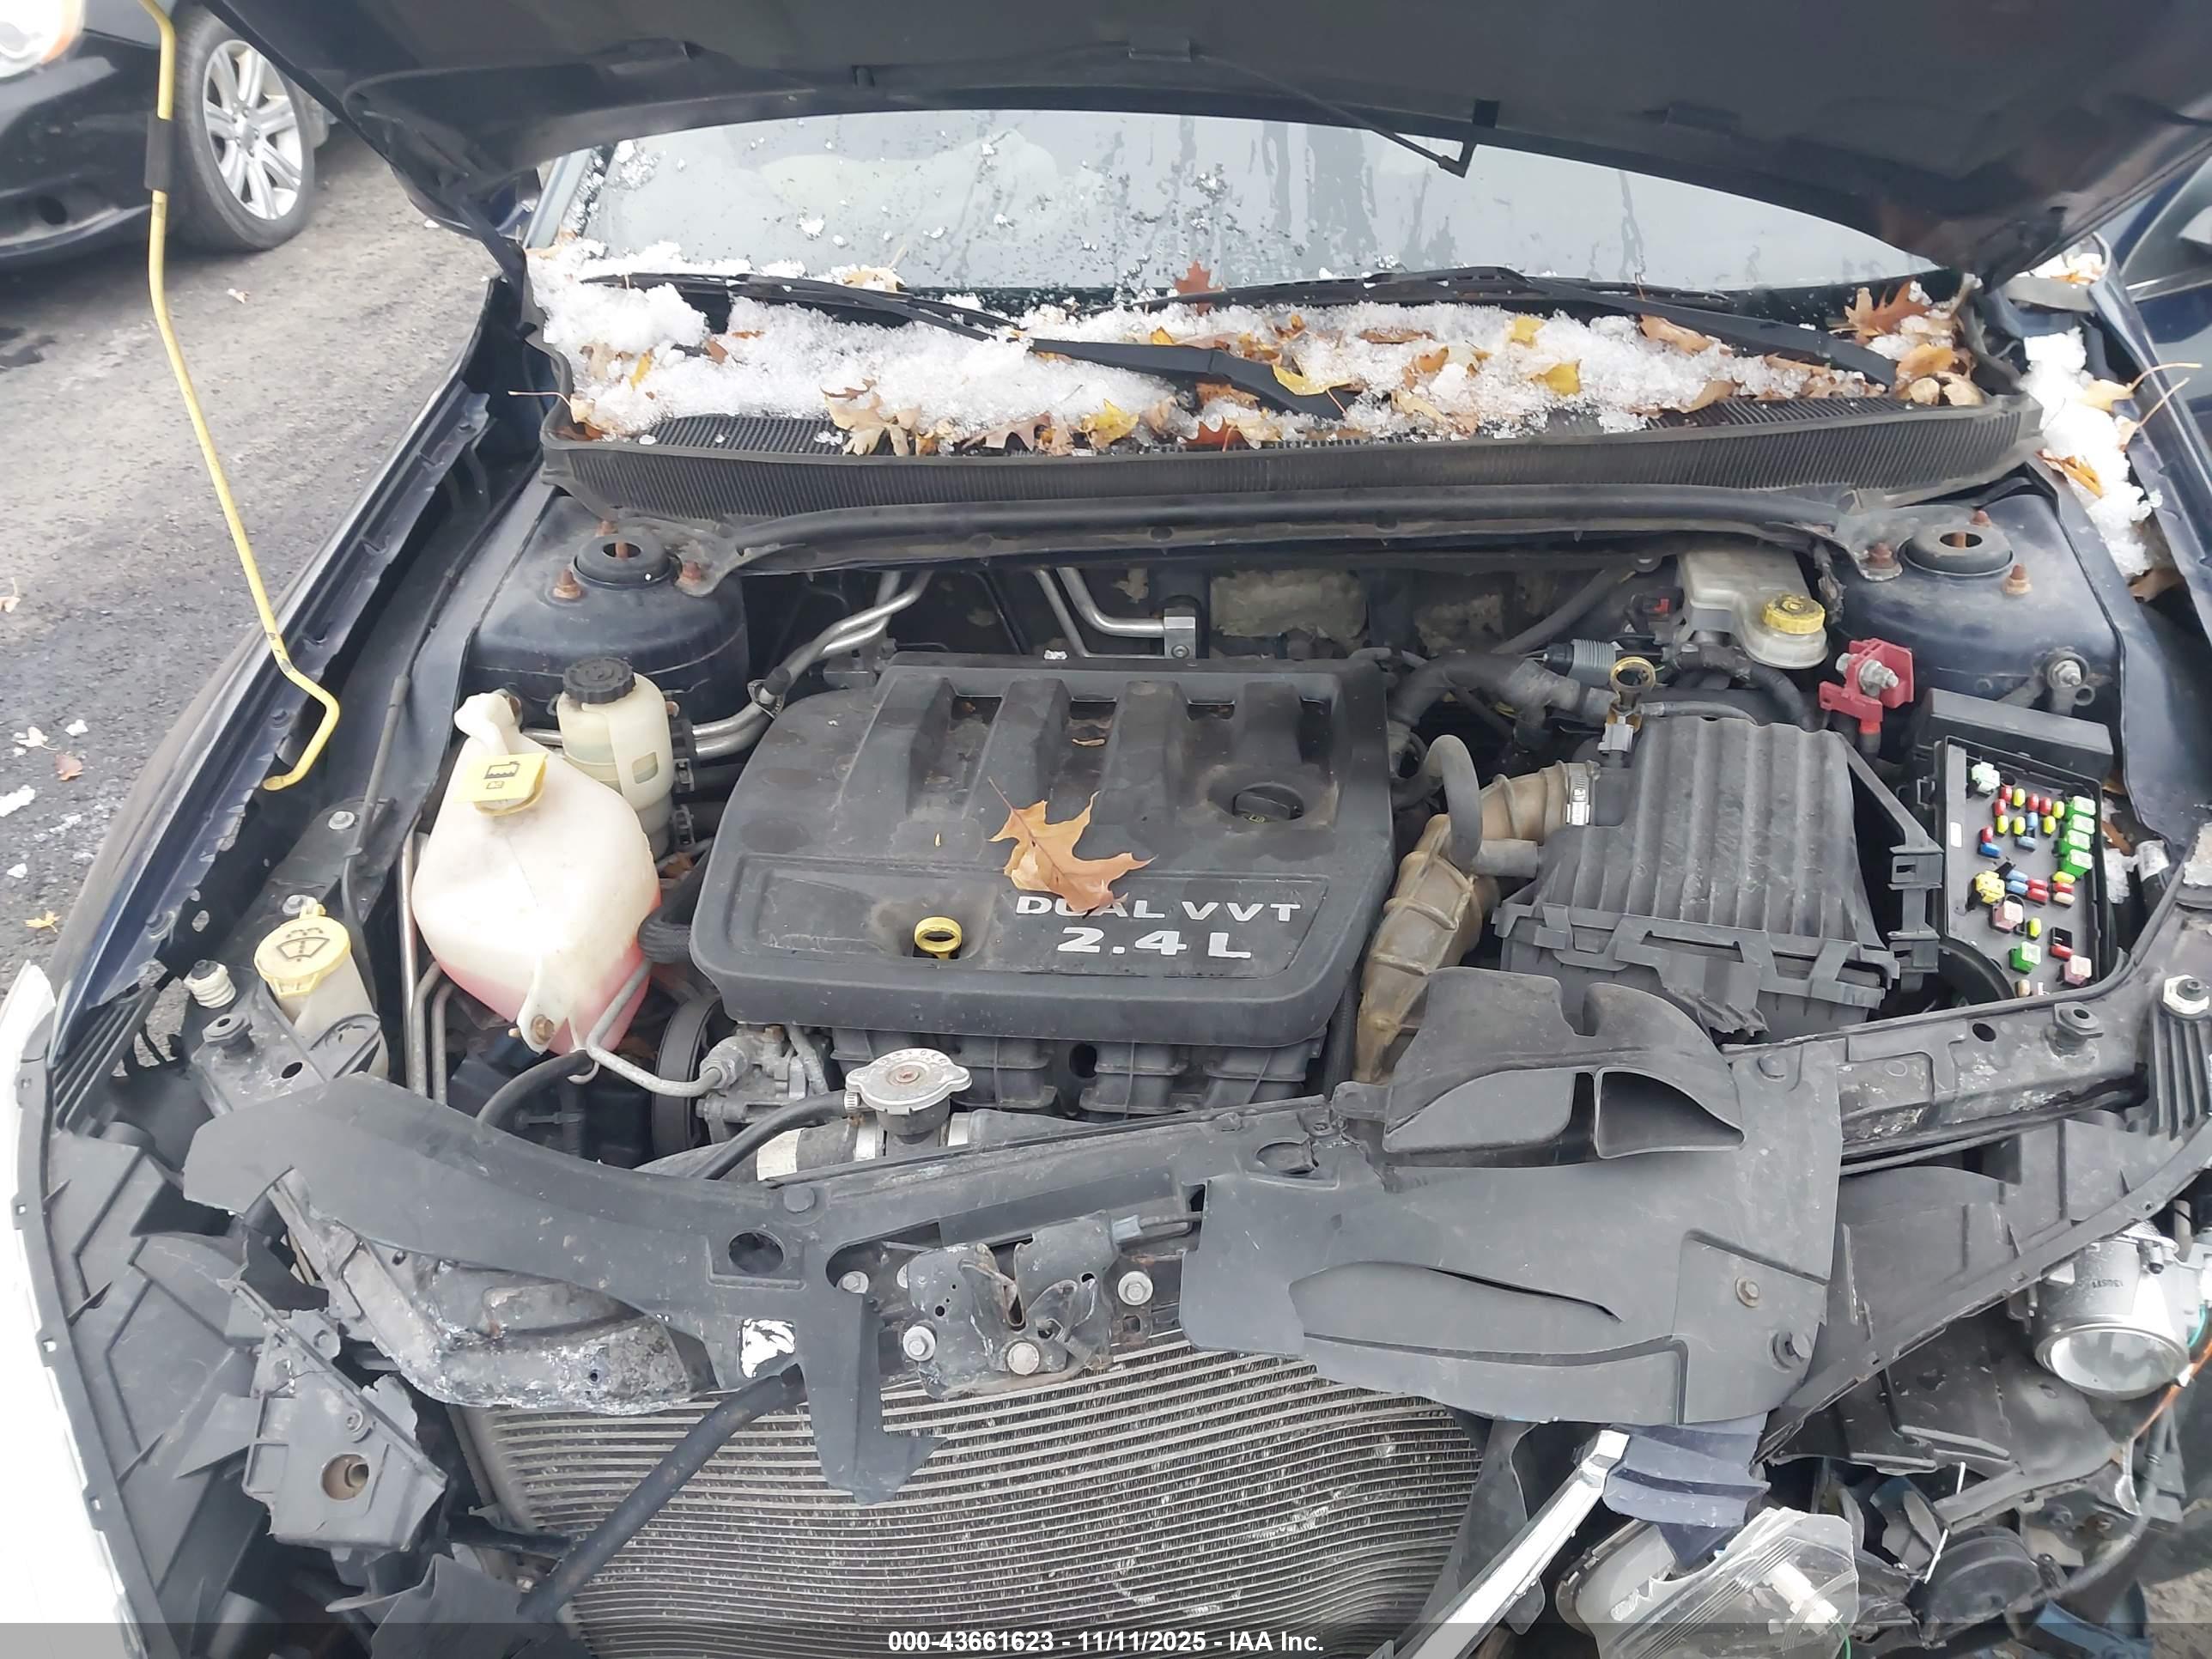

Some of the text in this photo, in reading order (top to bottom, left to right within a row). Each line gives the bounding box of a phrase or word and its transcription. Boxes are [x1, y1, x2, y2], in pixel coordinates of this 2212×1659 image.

[1016, 896, 1301, 921] DUAL VVT
[1057, 927, 1252, 958] 2.4 L
